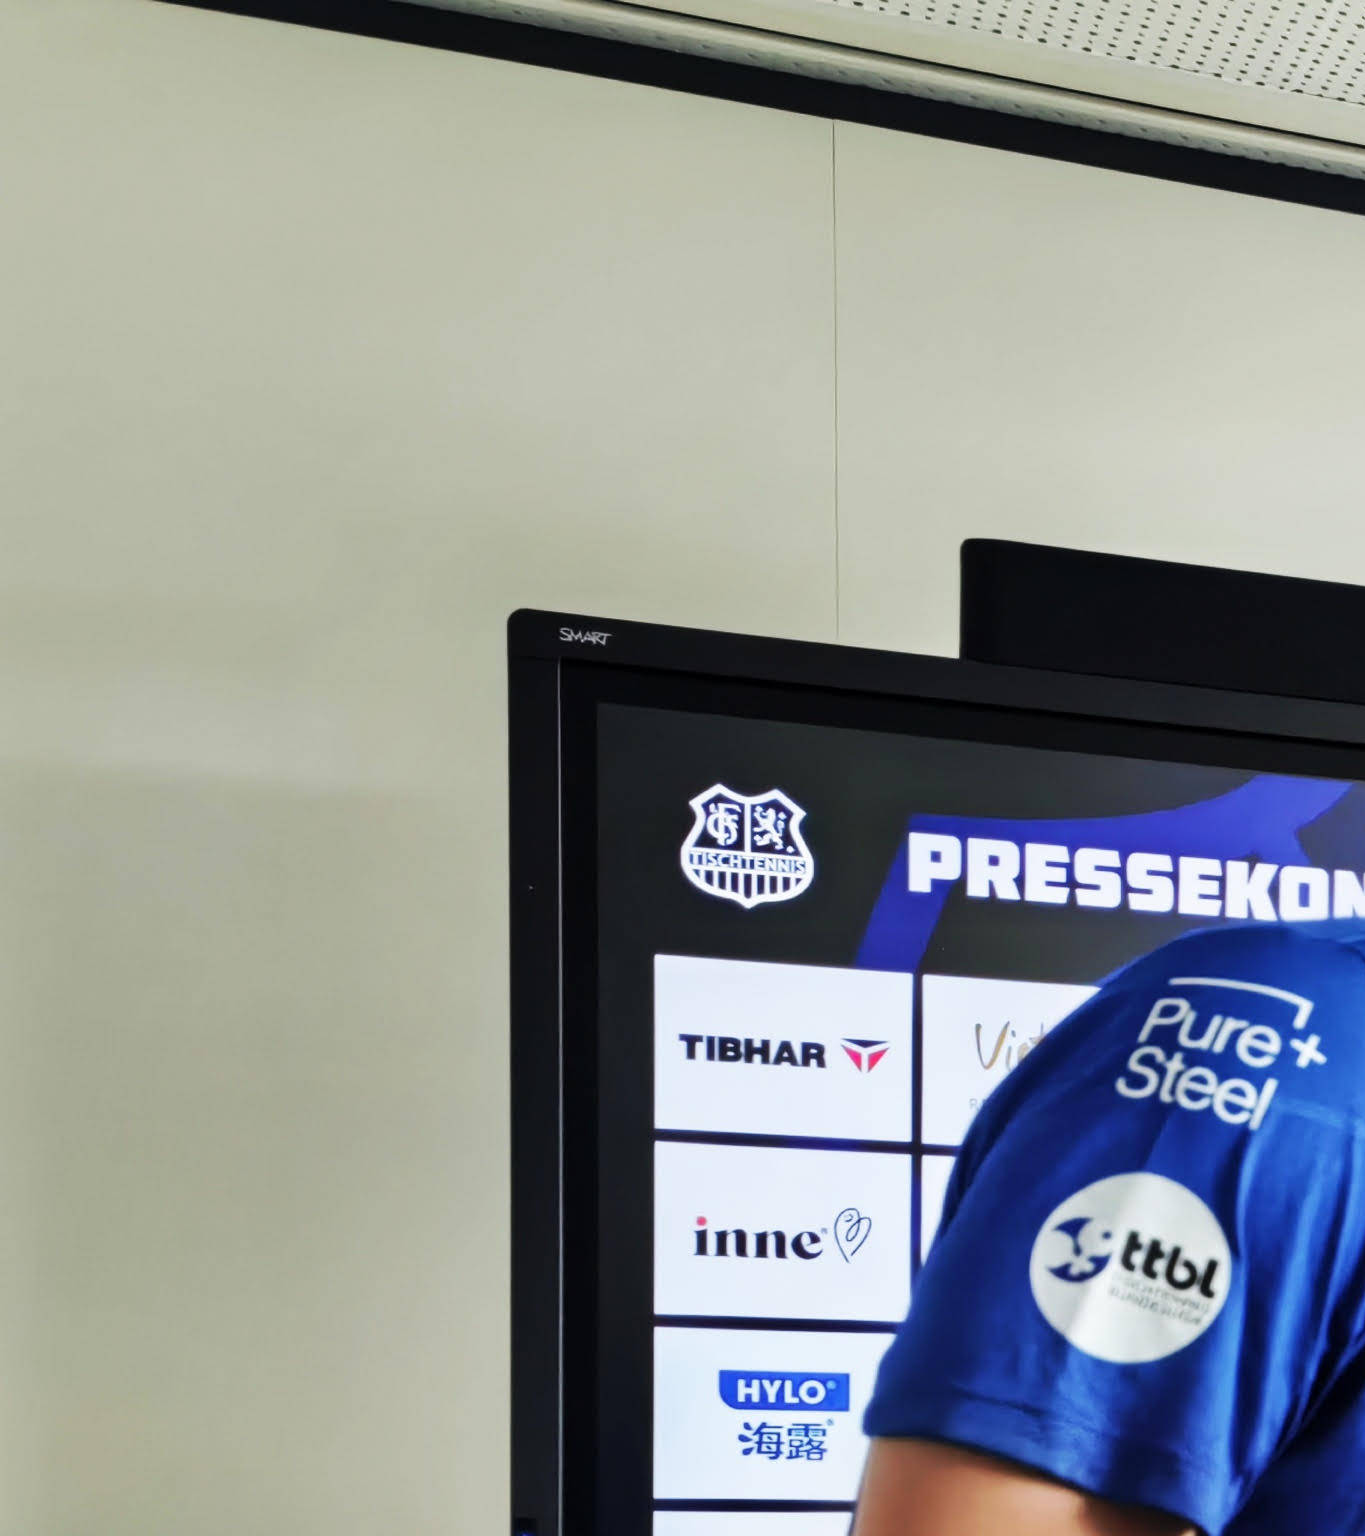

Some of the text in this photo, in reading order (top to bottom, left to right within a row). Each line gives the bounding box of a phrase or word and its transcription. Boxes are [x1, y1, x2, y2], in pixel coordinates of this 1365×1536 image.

[560, 627, 613, 646] SMART
[689, 851, 807, 875] TISCHTENNIS
[679, 1033, 827, 1069] TIBHAR
[1114, 1046, 1279, 1131] Steel
[693, 1216, 824, 1261] inne
[1120, 1230, 1219, 1299] ttbl
[736, 1378, 827, 1405] HYLO
[738, 1421, 828, 1462] 海露
